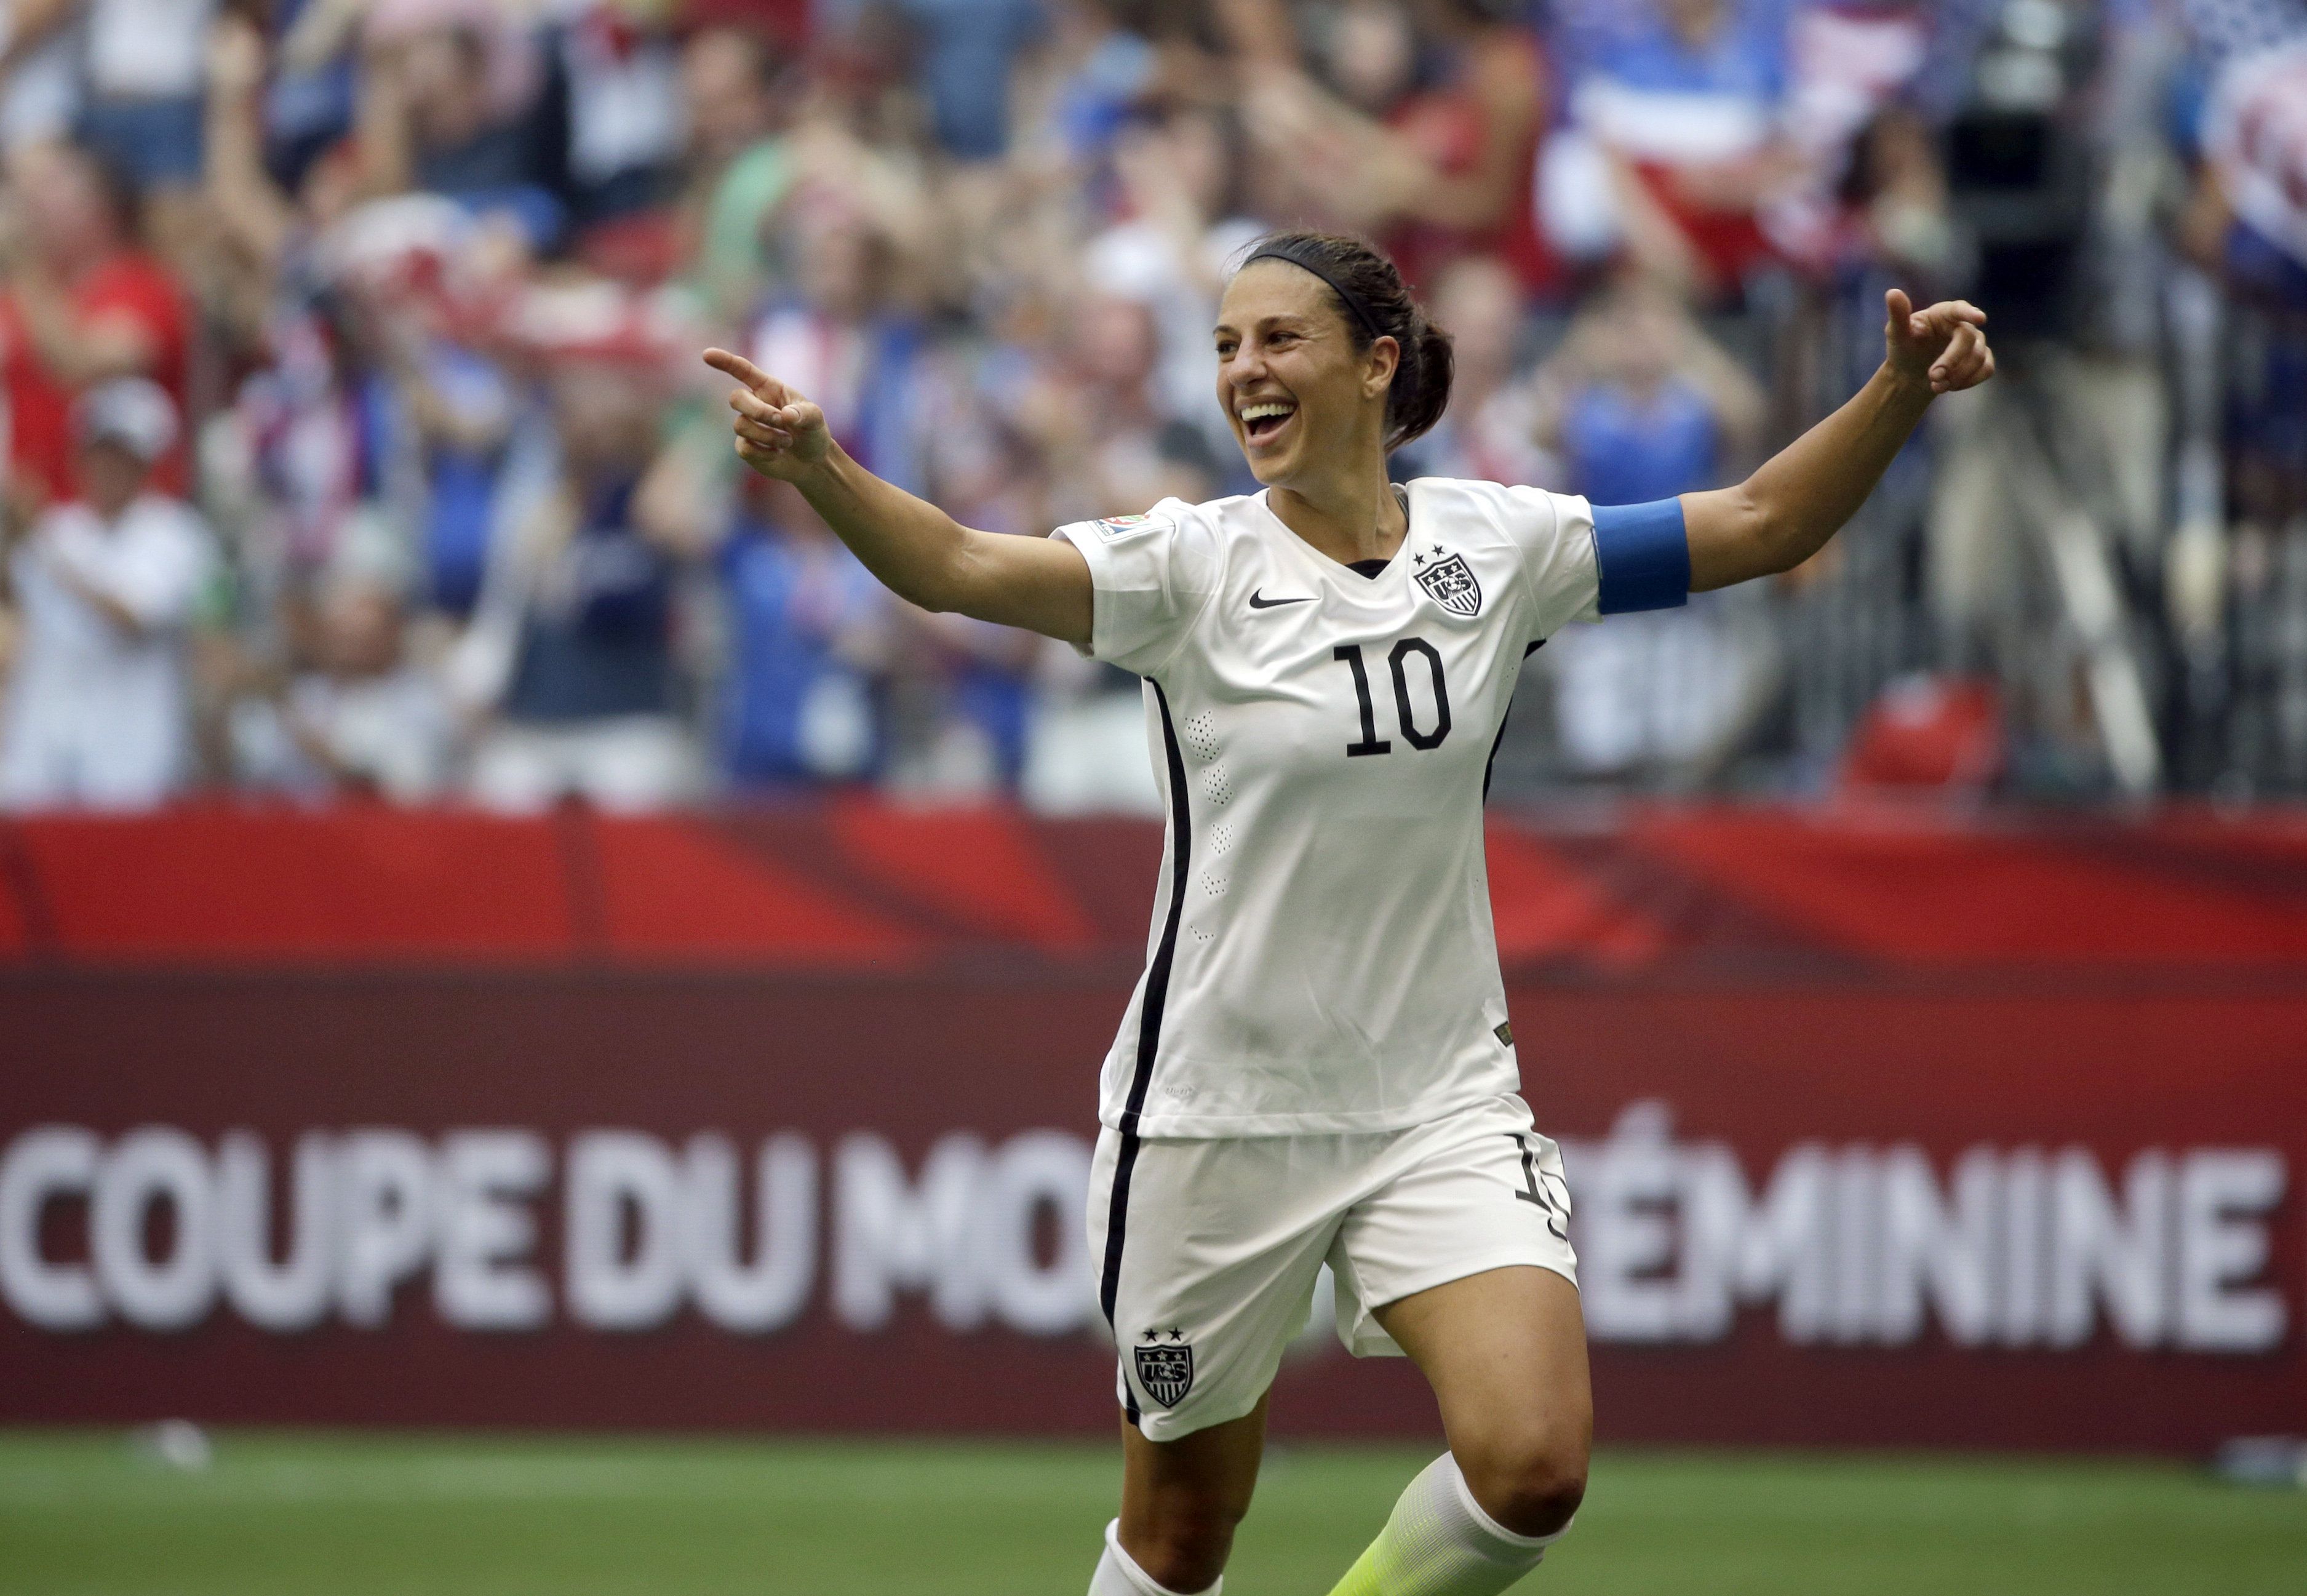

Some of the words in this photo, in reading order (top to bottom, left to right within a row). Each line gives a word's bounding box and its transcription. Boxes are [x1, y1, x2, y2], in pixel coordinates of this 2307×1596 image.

[1333, 636, 1452, 758] 10
[1, 1129, 549, 1331] COUPE
[567, 1131, 815, 1331] DU
